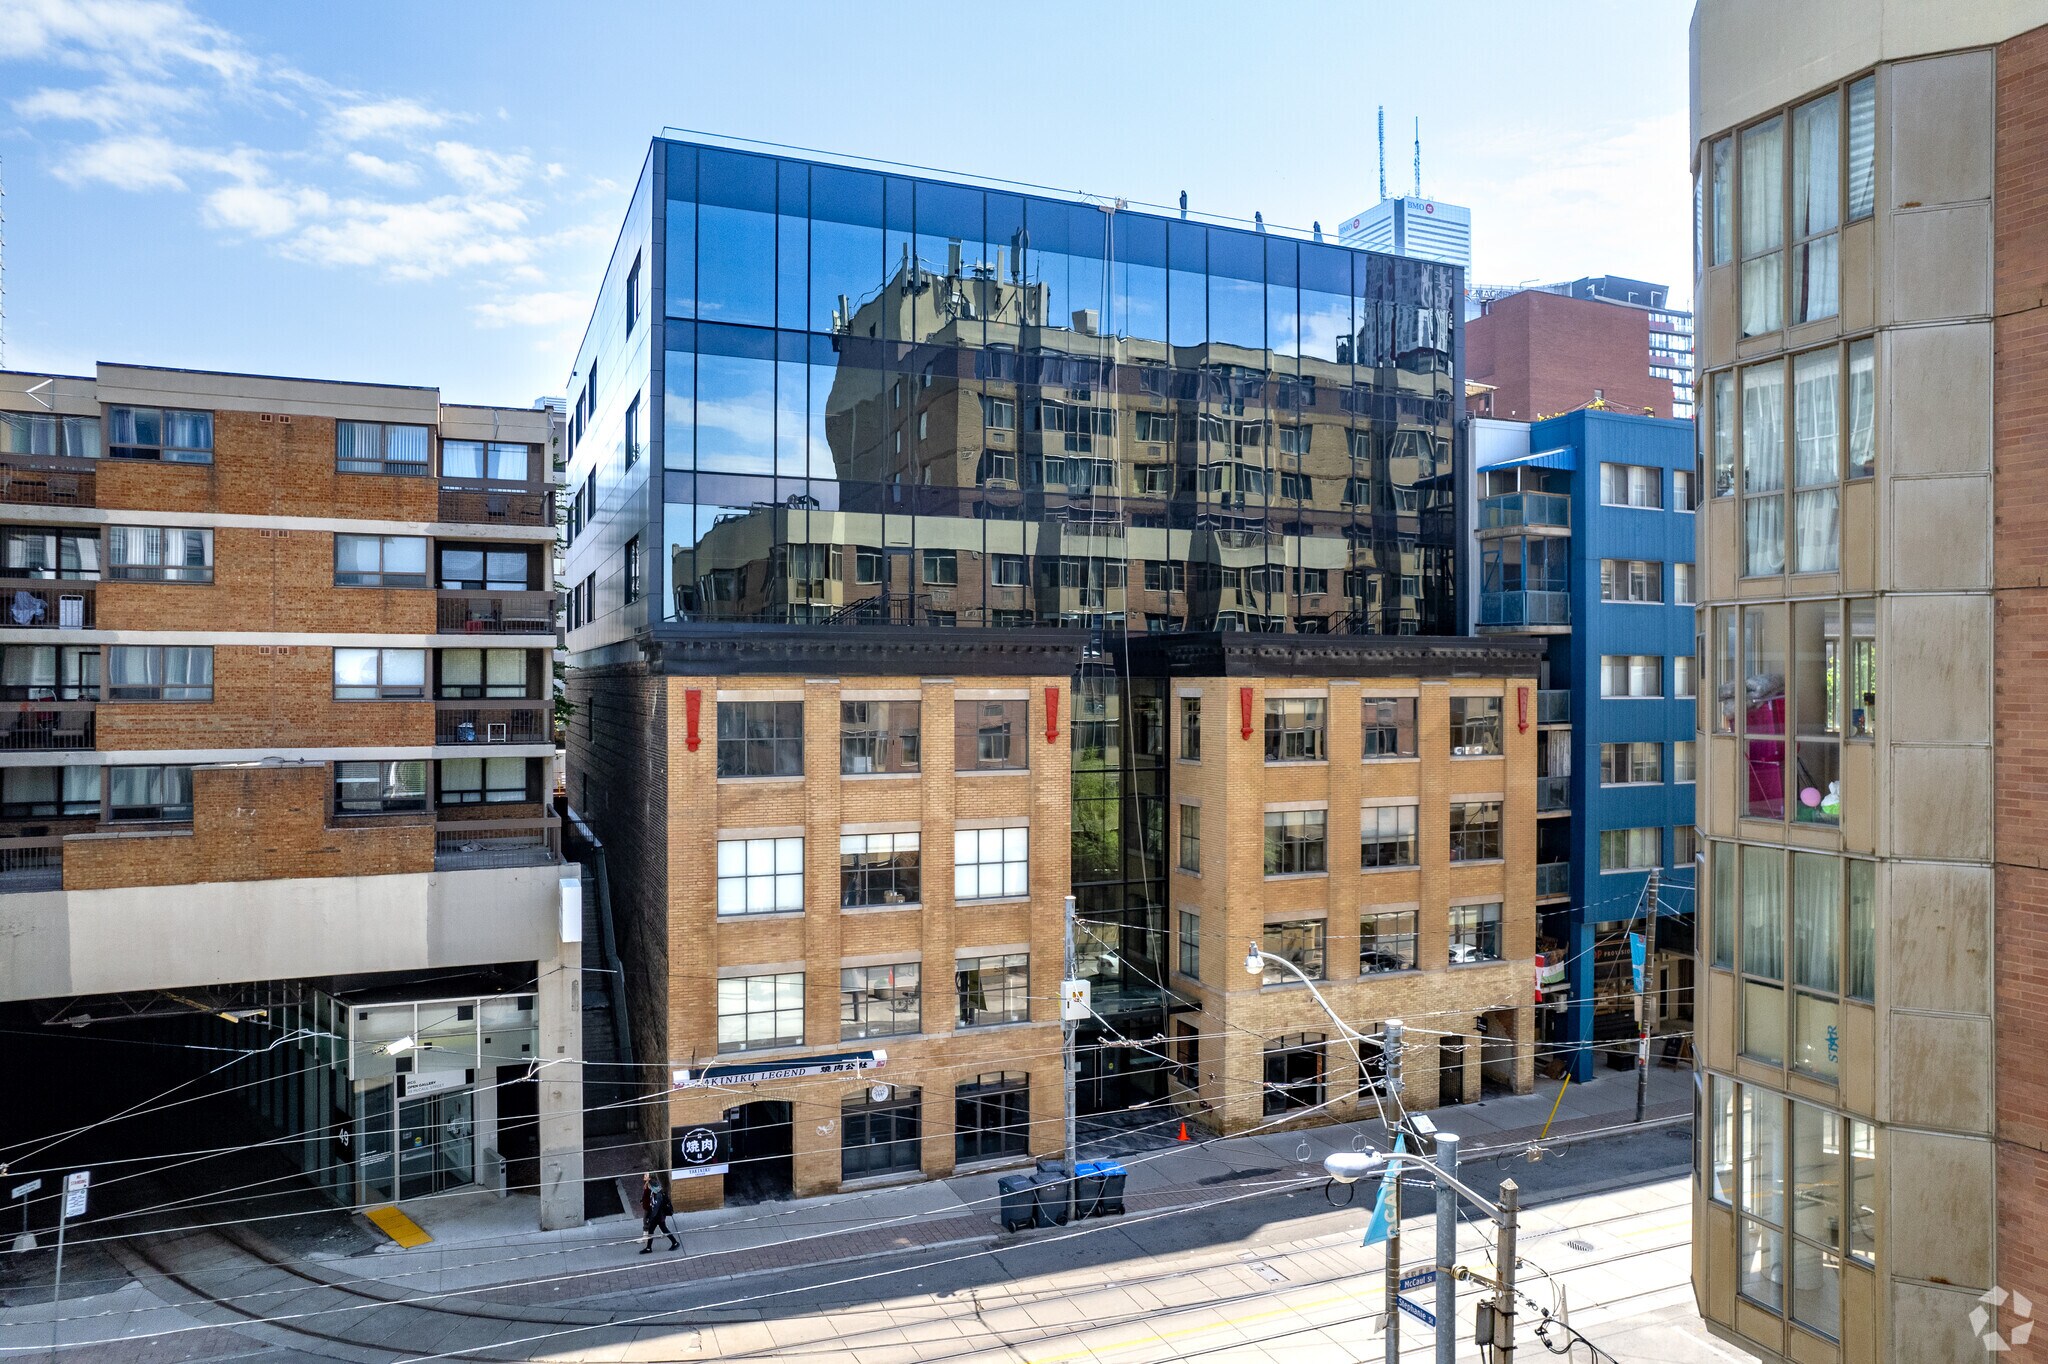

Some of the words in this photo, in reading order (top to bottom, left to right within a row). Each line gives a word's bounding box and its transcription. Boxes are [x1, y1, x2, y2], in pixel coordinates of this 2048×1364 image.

[1407, 202, 1425, 211] BMO
[1825, 1025, 1839, 1064] STAR
[696, 1074, 755, 1088] AKINIKU
[761, 1069, 806, 1080] LEGEND
[339, 1128, 348, 1146] 49
[1404, 1276, 1426, 1289] McCaul
[1427, 1275, 1433, 1283] St
[1398, 1298, 1426, 1320] Stephanie
[1428, 1316, 1434, 1325] St
